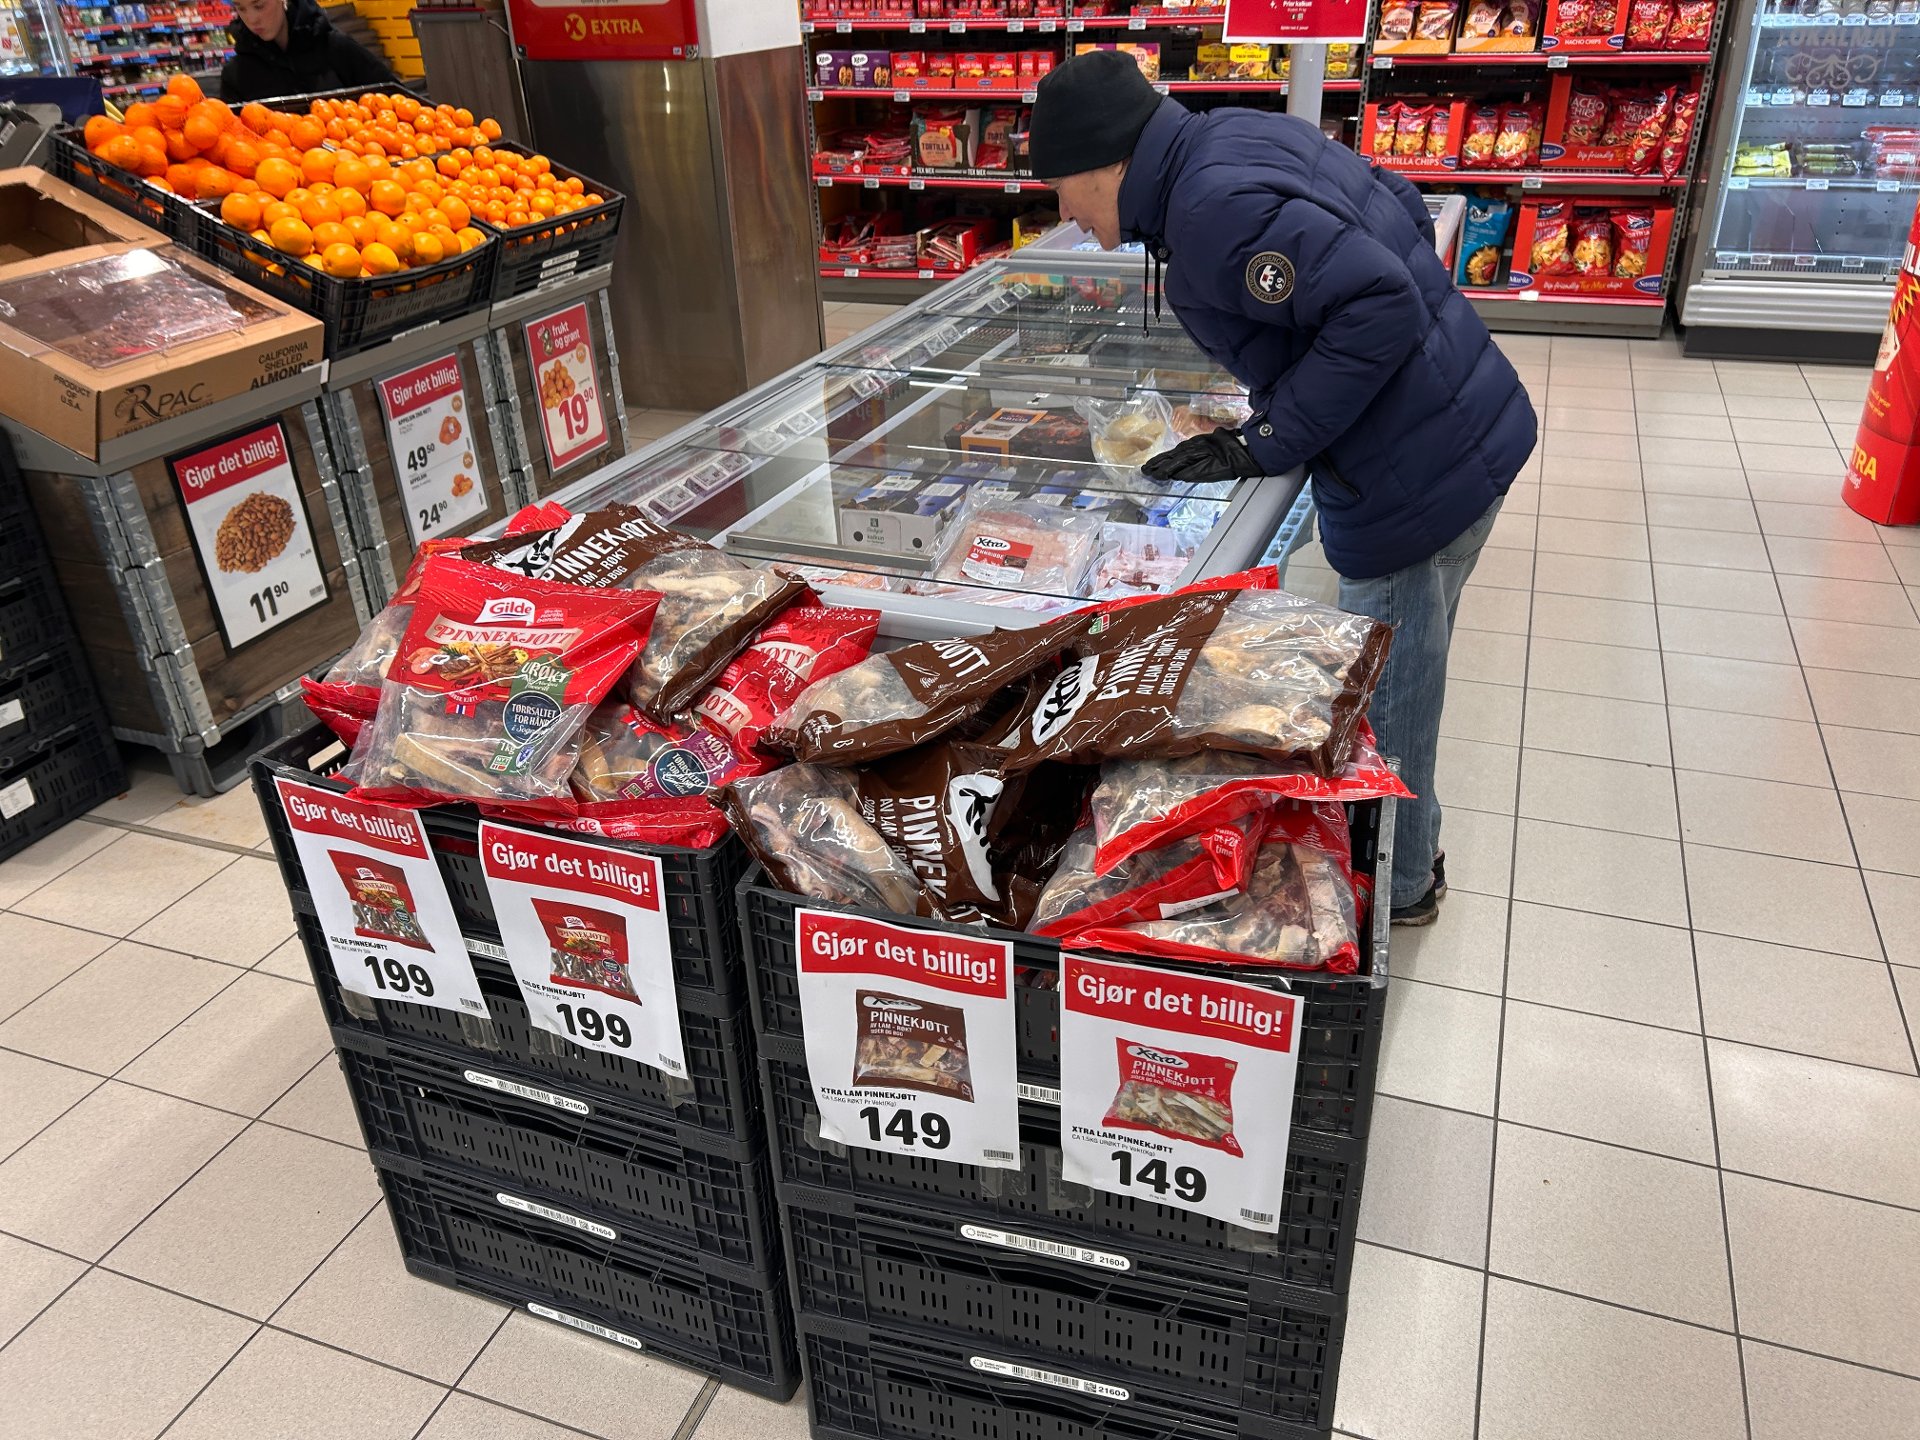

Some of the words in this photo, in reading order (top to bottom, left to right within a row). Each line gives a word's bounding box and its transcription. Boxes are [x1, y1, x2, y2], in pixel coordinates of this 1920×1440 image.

[590, 18, 644, 35] EXTRA
[921, 142, 950, 151] TORTILLA
[1375, 156, 1414, 165] TORTILLA
[1415, 157, 1440, 166] CHIPS
[552, 321, 570, 337] frukt
[554, 337, 564, 350] og
[563, 329, 580, 346] grønt
[258, 341, 308, 364] CALIFORNIA
[264, 353, 302, 373] SHELLED
[53, 373, 91, 397] PRODUCT
[250, 359, 314, 390] ALMONDS
[66, 391, 77, 400] OF
[392, 385, 413, 407] Gjør
[414, 376, 431, 396] det
[431, 364, 460, 389] billig!
[559, 393, 589, 440] 19
[583, 386, 594, 403] 90
[185, 462, 217, 489] Gjør
[218, 452, 242, 477] det
[241, 434, 280, 465] billig!
[407, 446, 428, 472] 49
[426, 443, 436, 454] 50
[1852, 444, 1877, 481] TRA
[419, 504, 441, 532] 24
[438, 500, 448, 512] 90
[540, 517, 669, 582] PINNEKJØTT
[977, 537, 1007, 549] Xtra
[602, 547, 629, 570] RØKT
[597, 574, 611, 589] OG
[249, 586, 279, 623] 11
[273, 581, 290, 598] 90
[488, 600, 532, 615] Gilde
[1141, 664, 1165, 682] LAM
[1167, 660, 1185, 672] OG
[1136, 684, 1155, 695] AV
[1158, 671, 1180, 695] SIDER
[511, 703, 557, 719] TØRRSALTET
[514, 715, 529, 725] FOR
[879, 798, 893, 813] AV
[289, 795, 327, 822] Gjør
[331, 807, 360, 831] det
[362, 816, 417, 846] billig!
[898, 795, 947, 900] PINNEK
[492, 842, 538, 871] Gjør
[544, 852, 585, 879] det
[590, 862, 651, 895] billig!
[348, 938, 388, 951] PINNEKJØTT
[812, 931, 868, 961] Gjør
[875, 939, 917, 967] det
[922, 949, 997, 984] billig!
[365, 955, 435, 998] 199
[522, 979, 541, 991] GILDE
[541, 985, 586, 1000] PINNEKJØTT
[1077, 973, 1137, 1005] Gjør
[1143, 987, 1193, 1016] det
[1201, 1000, 1283, 1036] billig!
[556, 1003, 632, 1049] 199
[870, 1011, 950, 1035] PINNEKJØTT
[878, 1023, 892, 1031] LAM
[1136, 1046, 1185, 1067] Xtra
[1131, 1069, 1142, 1078] AV
[1142, 1071, 1157, 1080] LAM
[1133, 1060, 1217, 1087] PINNEKJØTT
[821, 1087, 843, 1098] XTRA
[843, 1089, 863, 1099] LAM
[863, 1090, 917, 1102] PINNEKJØTT
[565, 1100, 587, 1113] 21604
[859, 1105, 951, 1150] 149
[1071, 1134, 1083, 1142] CA
[1071, 1125, 1096, 1138] XTRA
[1097, 1130, 1117, 1142] LAM
[1117, 1134, 1175, 1155] PINNEKJØTT
[1111, 1150, 1207, 1203] 149
[1099, 1256, 1126, 1268] 21604
[1098, 1386, 1127, 1399] 21604
